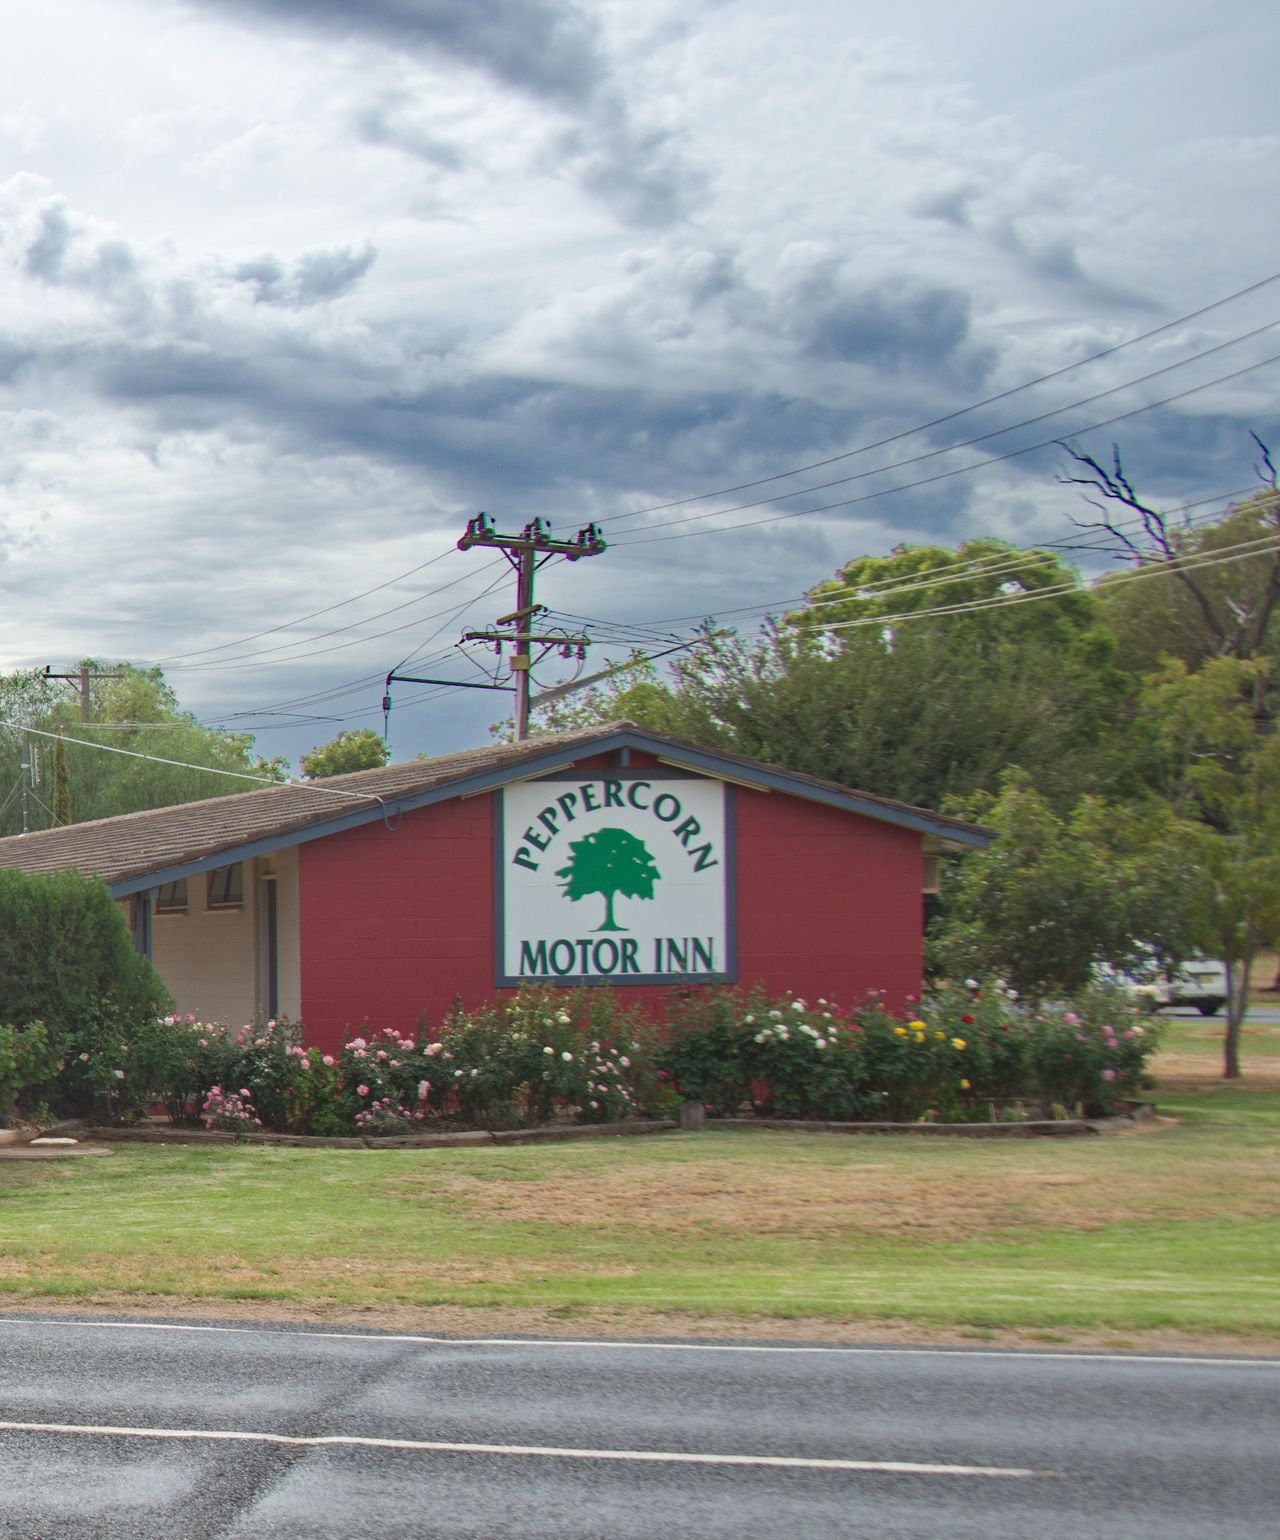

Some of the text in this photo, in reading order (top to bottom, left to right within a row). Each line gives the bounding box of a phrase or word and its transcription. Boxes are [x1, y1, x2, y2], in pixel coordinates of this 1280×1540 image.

[512, 780, 719, 873] PEPPERCORN
[519, 936, 714, 976] MOTOR INN
